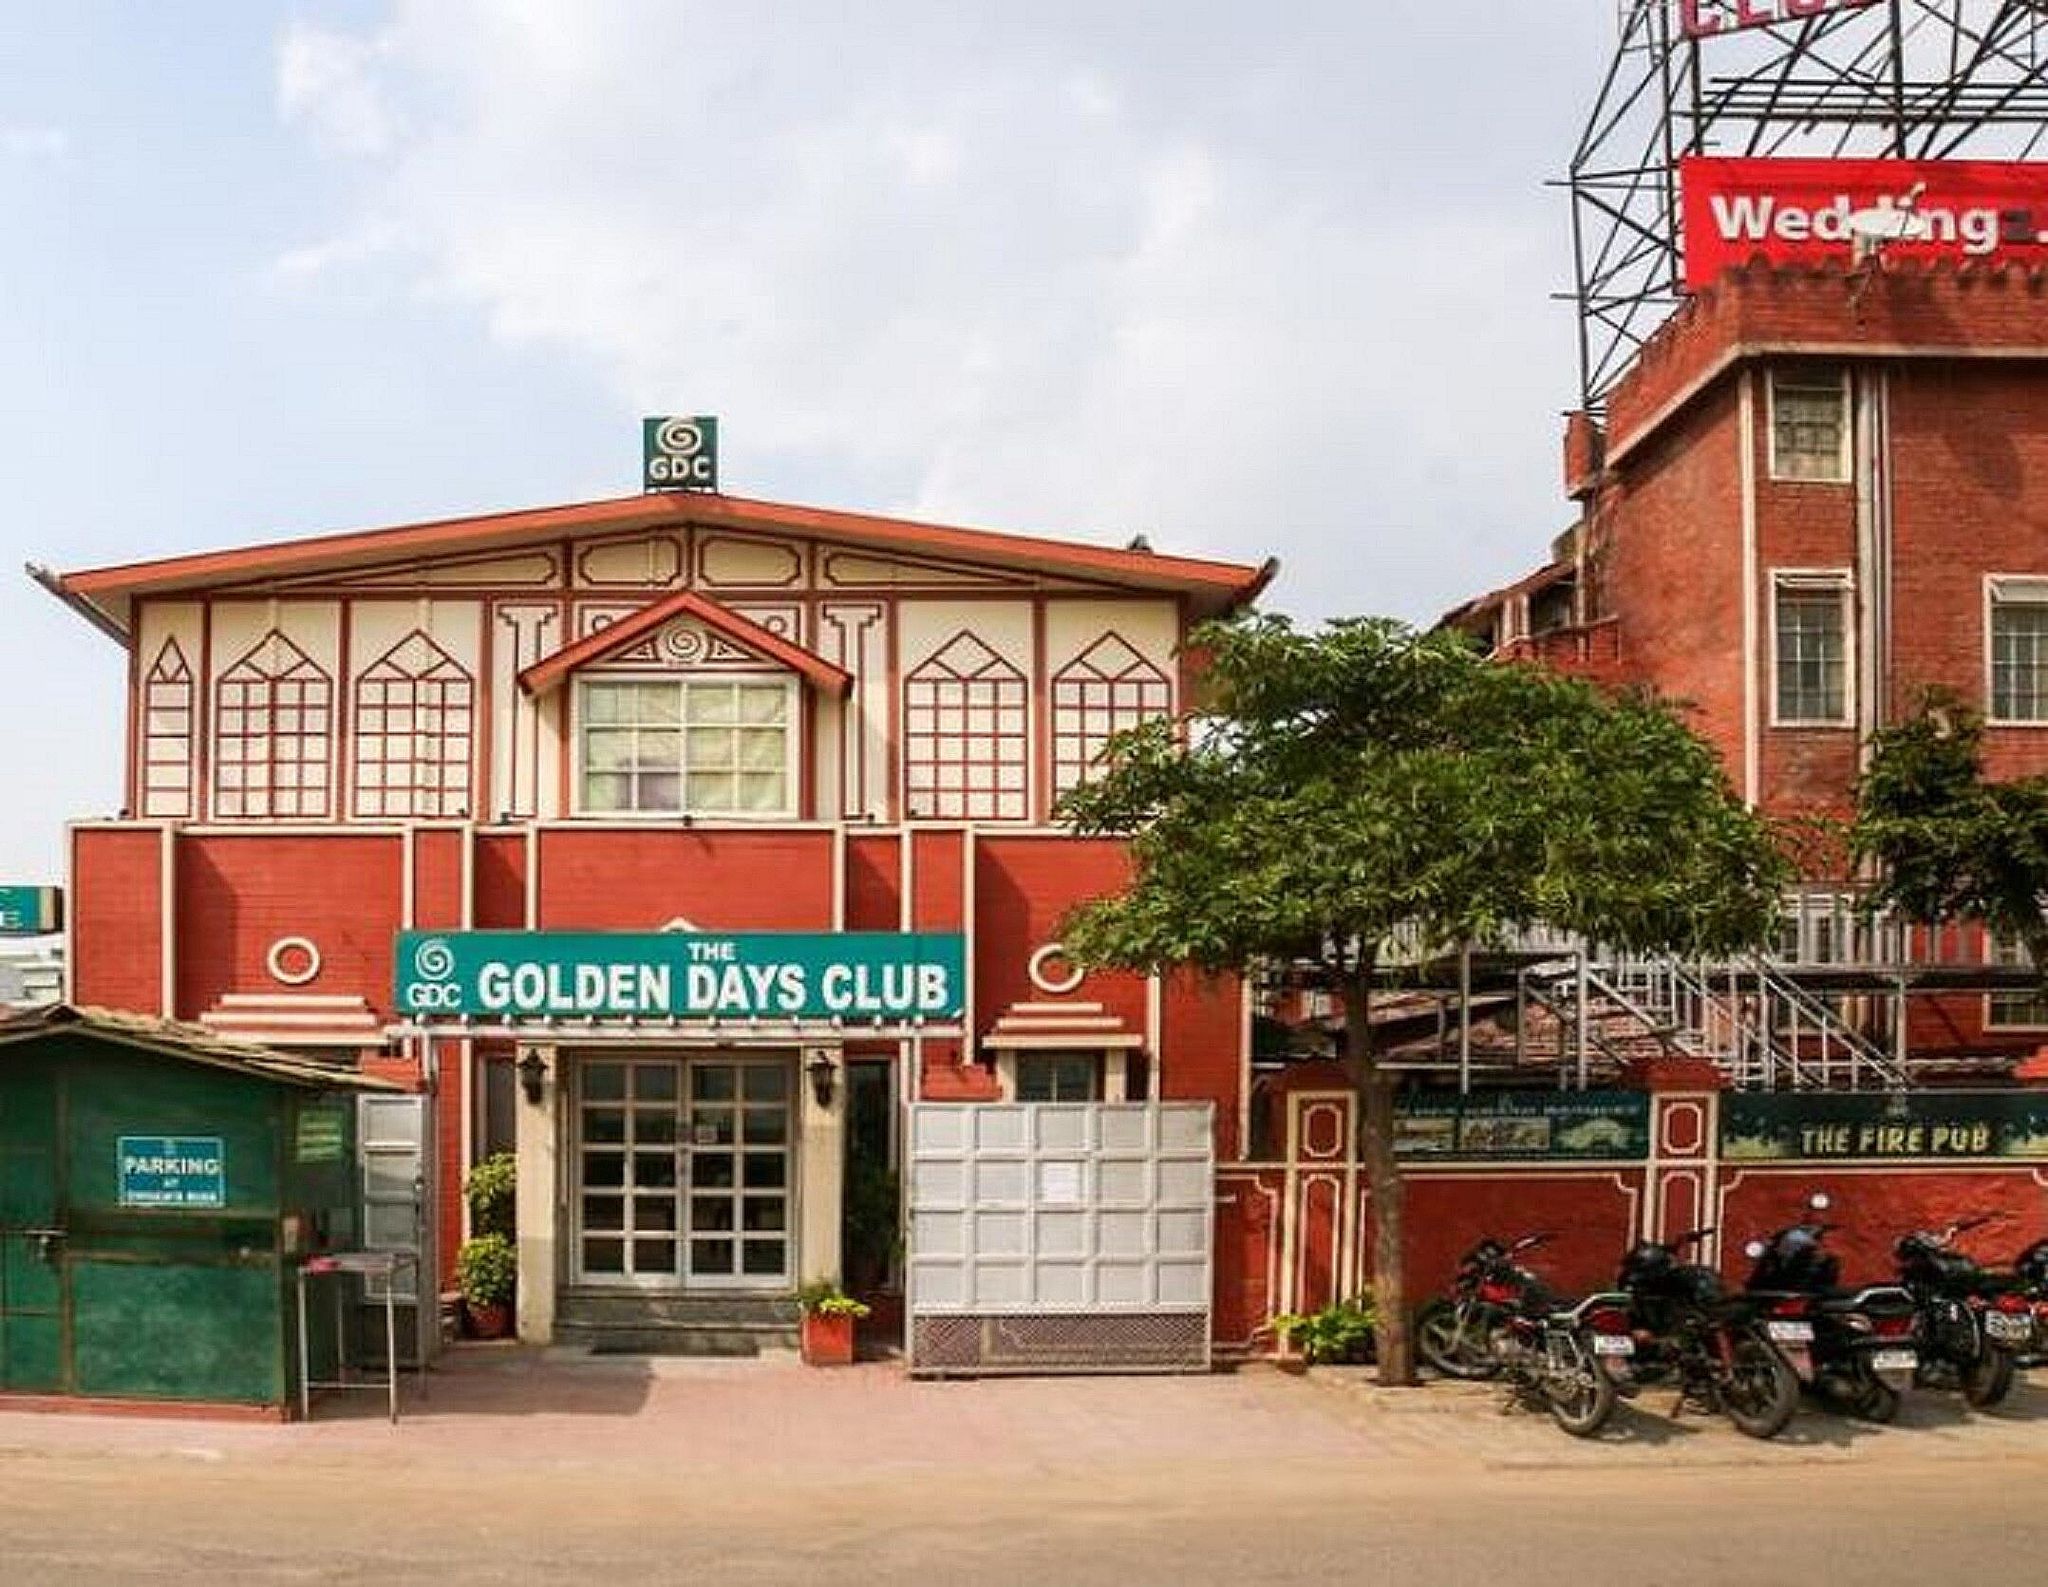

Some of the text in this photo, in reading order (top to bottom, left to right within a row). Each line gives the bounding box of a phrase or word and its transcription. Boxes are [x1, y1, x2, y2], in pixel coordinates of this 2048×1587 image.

[1710, 194, 1999, 255] Wedng
[648, 456, 711, 480] GDC
[687, 941, 736, 961] THE
[406, 982, 463, 1008] GDC
[479, 961, 949, 1011] GOLDEN DAYS CLUB
[1800, 1123, 1990, 1154] THE FIRE PUB
[123, 1155, 221, 1175] PARKING
